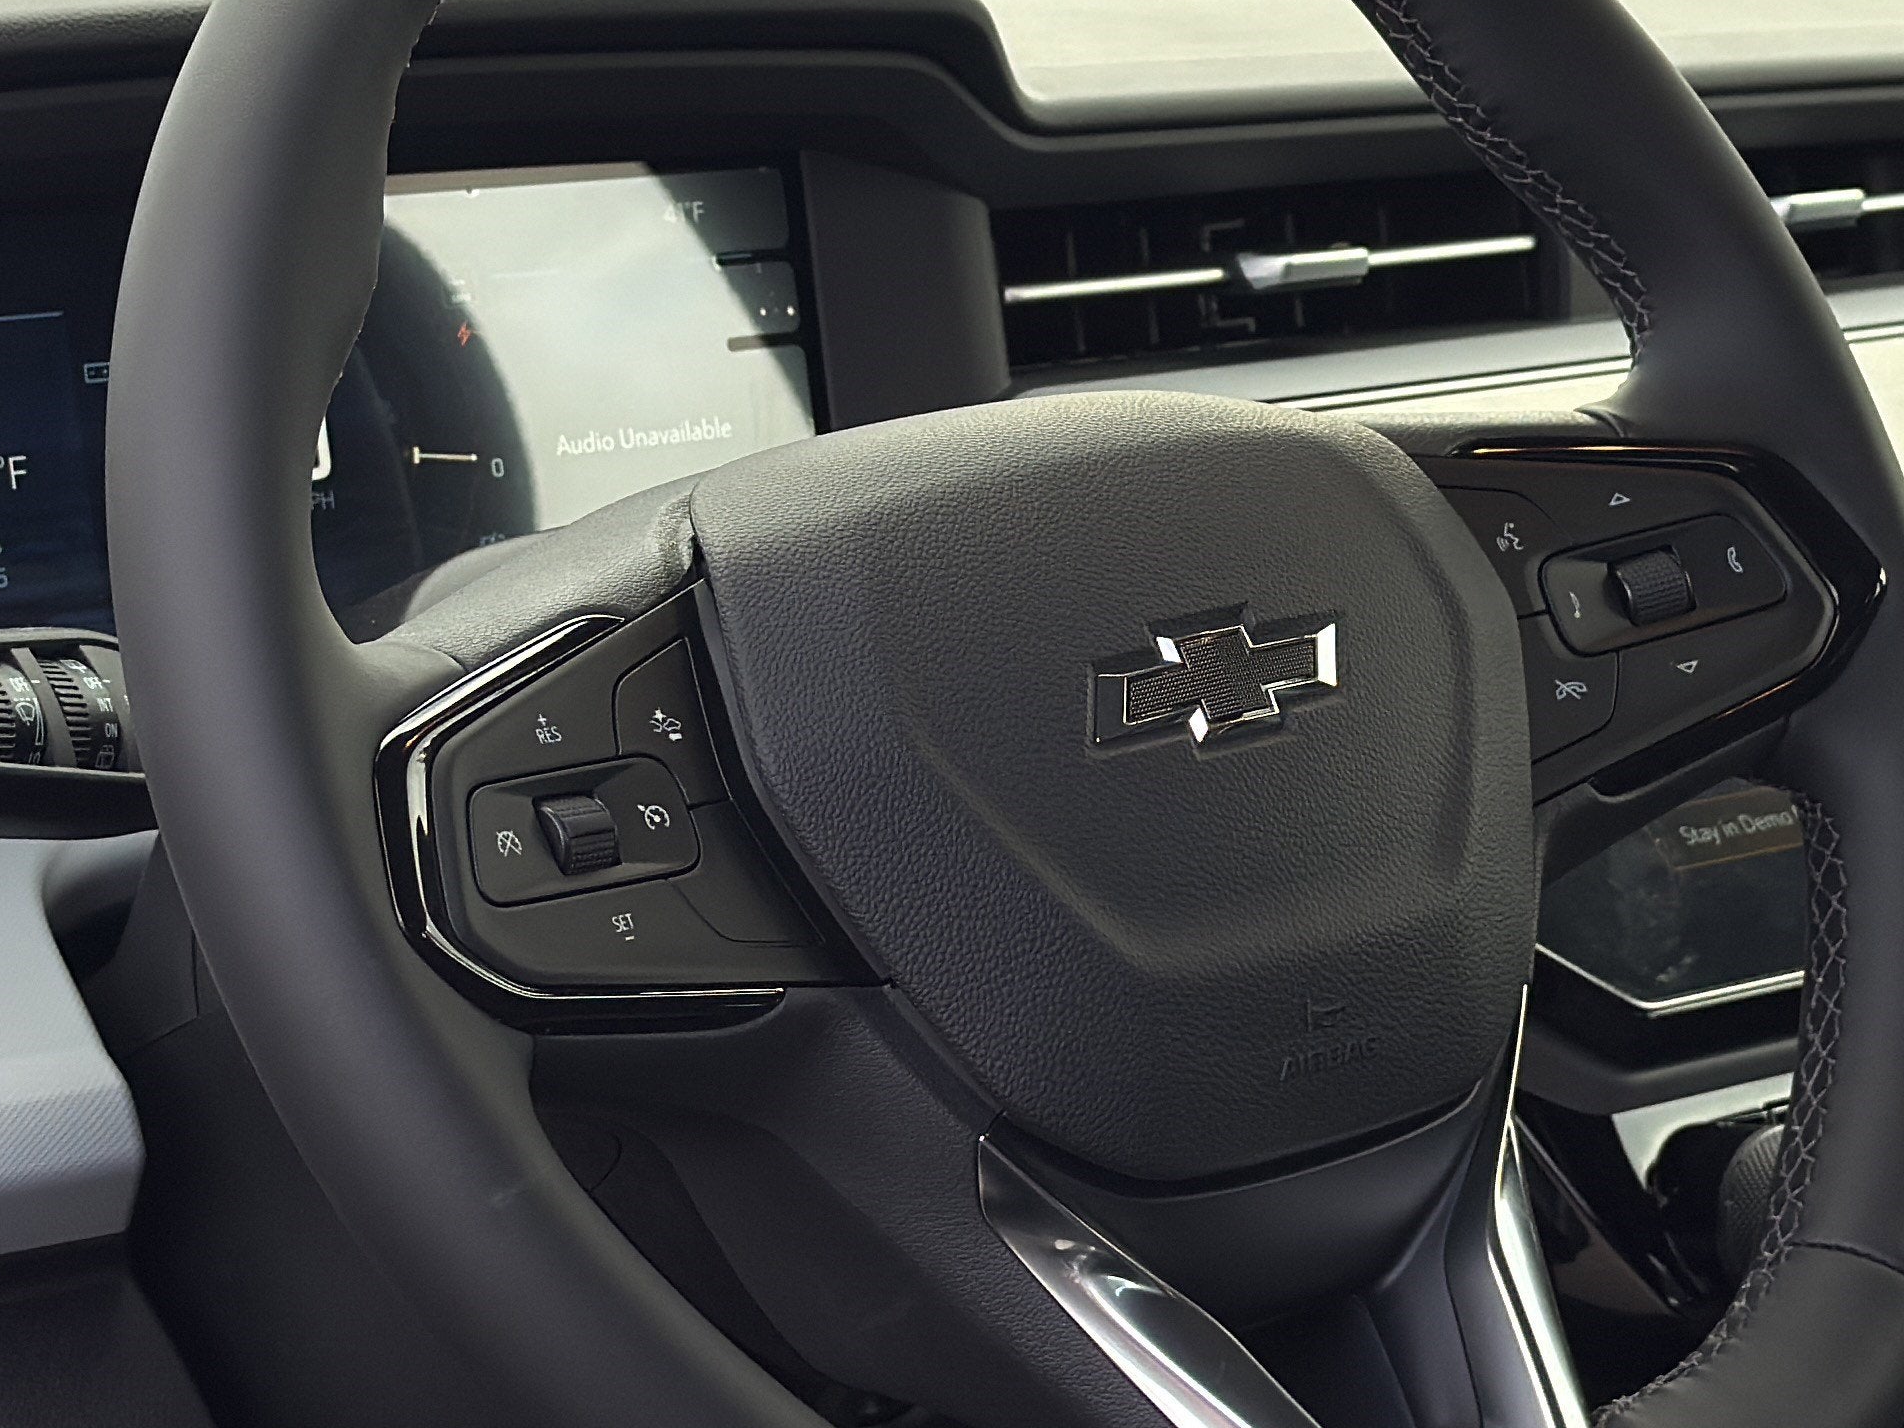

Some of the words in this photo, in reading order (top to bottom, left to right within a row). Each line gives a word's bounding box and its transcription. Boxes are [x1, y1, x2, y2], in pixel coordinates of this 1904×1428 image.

[556, 431, 615, 456] Audio
[619, 416, 732, 449] Unavailable
[105, 722, 119, 738] ON
[536, 725, 563, 745] RES
[1679, 824, 1722, 846] Stay
[1720, 820, 1740, 838] in
[1737, 809, 1794, 835] Demo
[611, 913, 635, 934] SET
